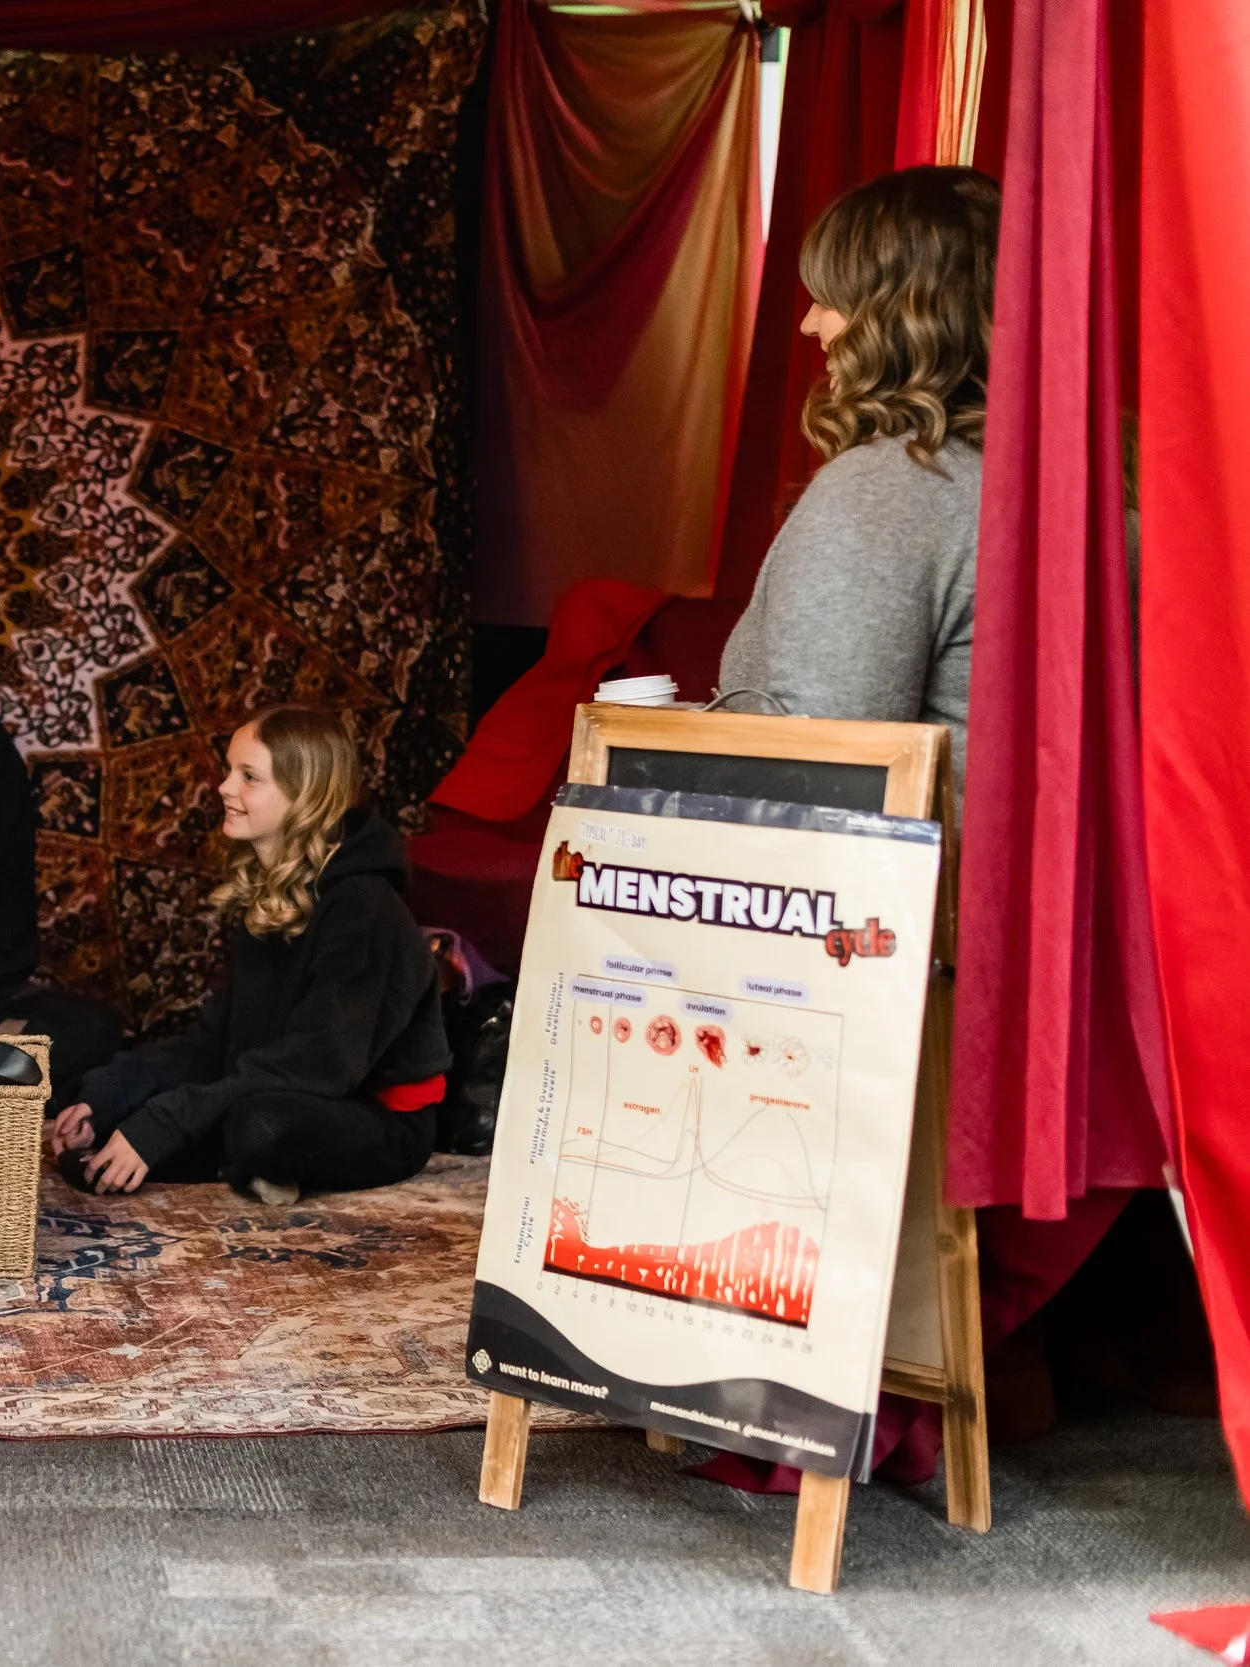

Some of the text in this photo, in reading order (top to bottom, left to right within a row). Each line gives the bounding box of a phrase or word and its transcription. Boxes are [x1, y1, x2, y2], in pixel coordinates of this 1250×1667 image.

[553, 840, 583, 881] the
[578, 863, 842, 937] MENSTRUAL
[826, 917, 896, 967] cycle
[606, 959, 672, 978] follicular phase
[545, 982, 558, 1033] Follicular
[572, 985, 642, 1003] menstrual phase
[746, 980, 803, 998] luteal phase
[551, 972, 565, 1045] Development
[685, 1002, 726, 1016] ovulation
[529, 1117, 543, 1165] Pituitary
[539, 1059, 550, 1102] Ovarian
[538, 1070, 557, 1157] Hormone Levels
[623, 1101, 661, 1115] estrogen
[749, 1093, 810, 1111] progesterone
[576, 1126, 593, 1136] FSH
[514, 1196, 530, 1264] Endometrial
[524, 1216, 534, 1247] Cycle
[536, 1281, 543, 1290] 0
[554, 1285, 560, 1295] 2
[572, 1290, 578, 1298] 4
[626, 1302, 637, 1312] 10
[645, 1306, 655, 1317] 12
[499, 1361, 610, 1400] want to learn more?
